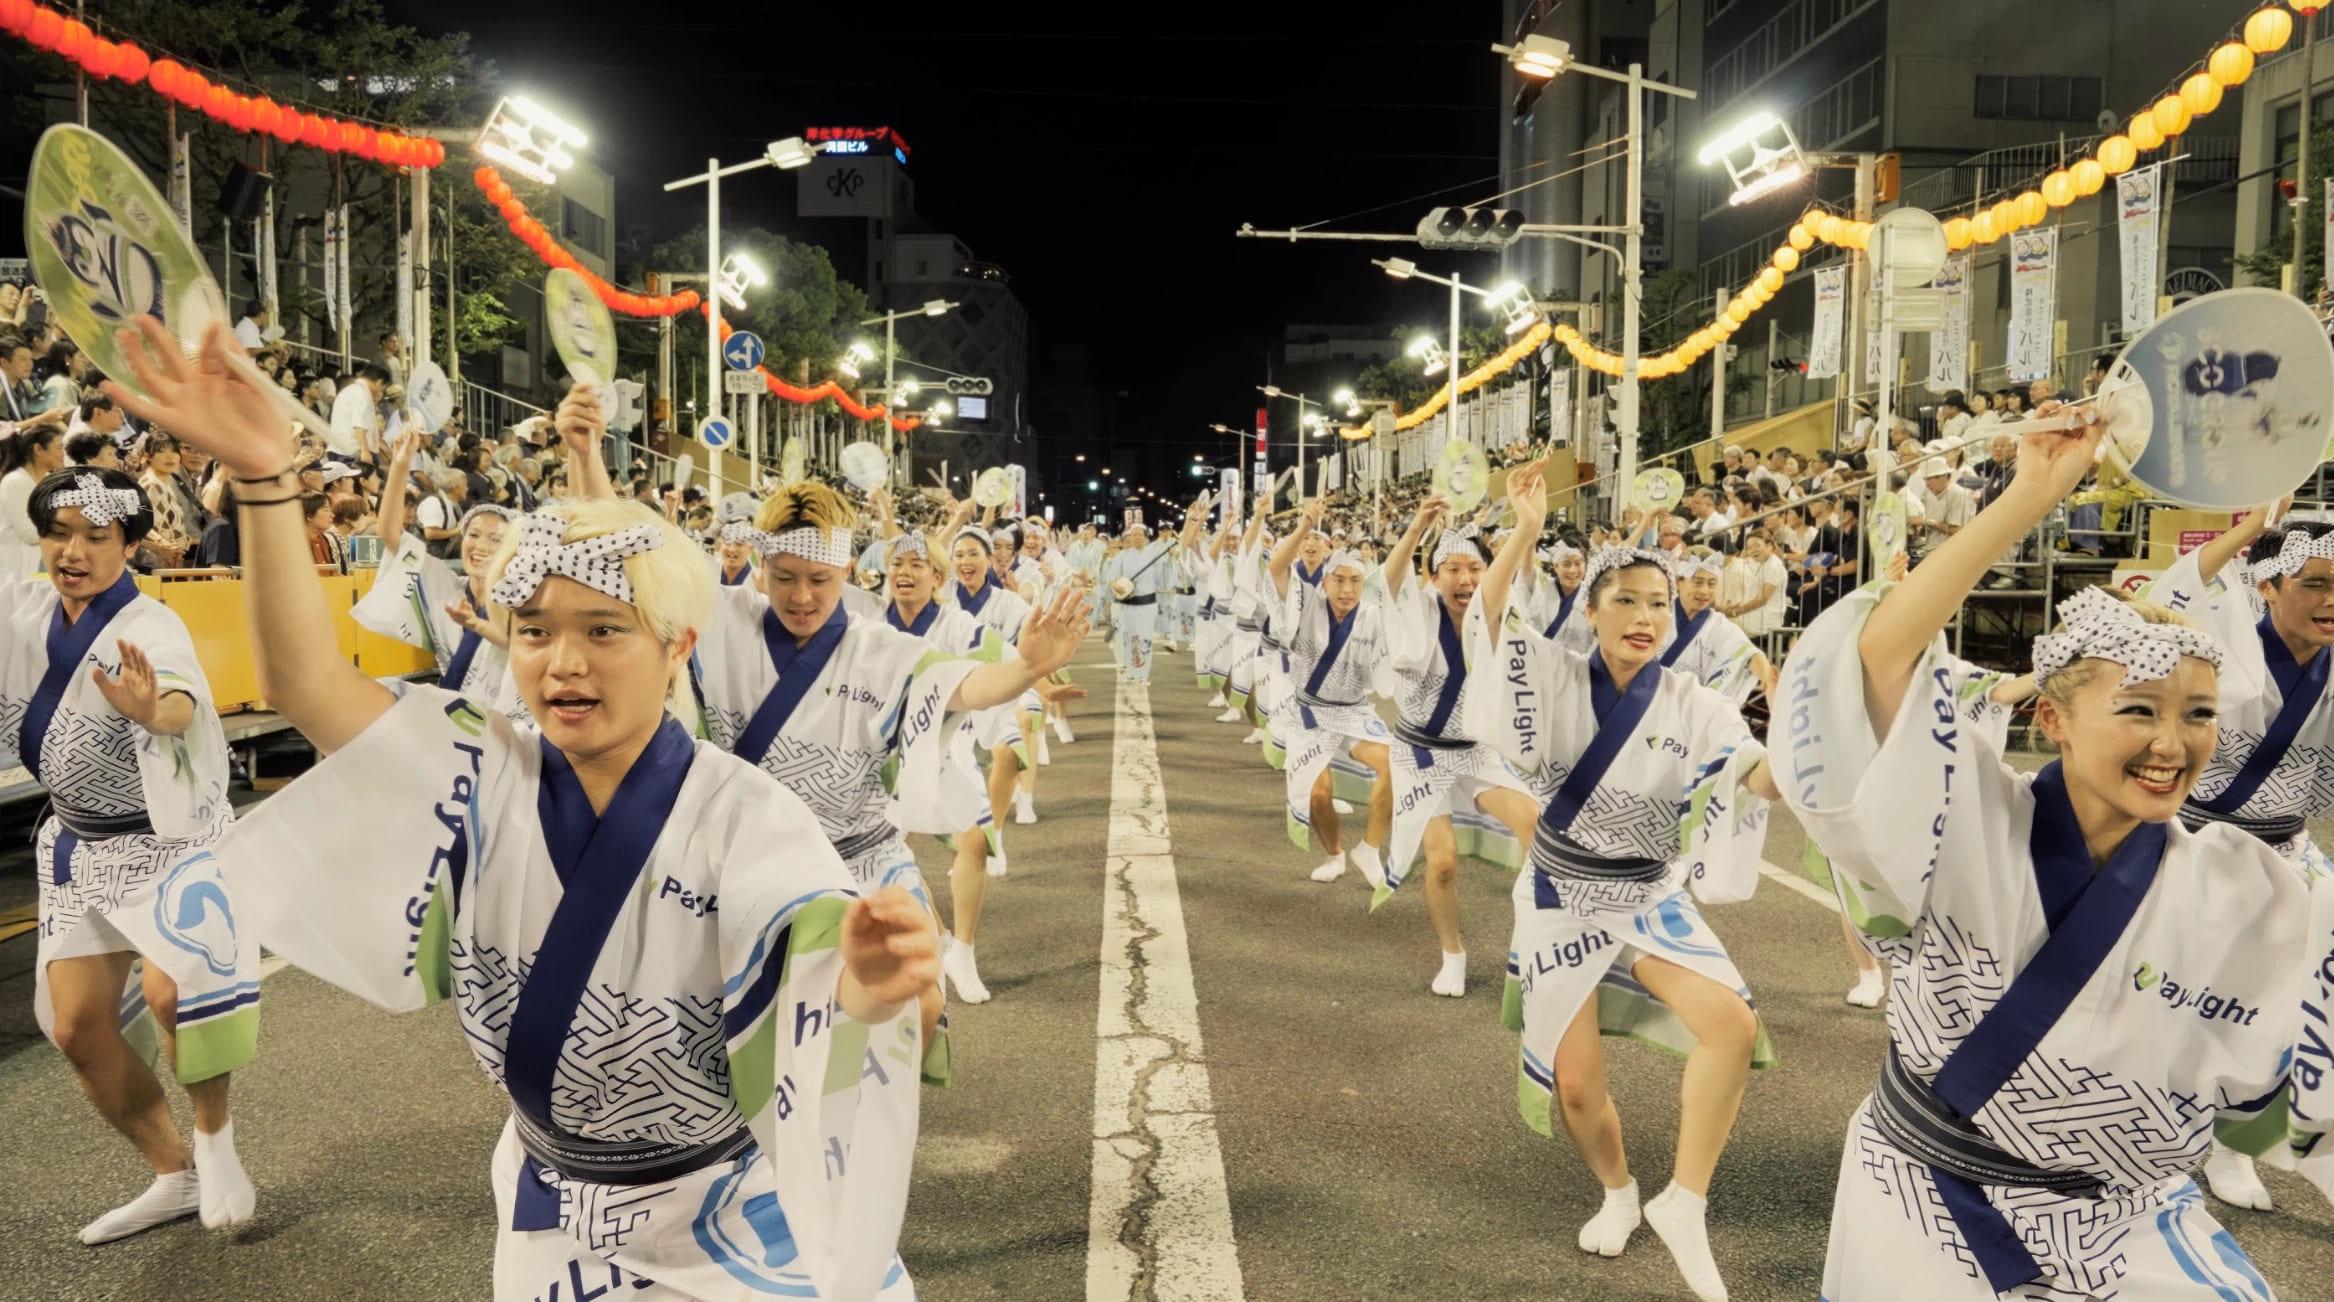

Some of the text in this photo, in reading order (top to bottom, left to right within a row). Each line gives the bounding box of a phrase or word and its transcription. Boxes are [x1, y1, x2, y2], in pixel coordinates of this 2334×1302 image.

[837, 684, 886, 711] PLight
[1507, 639, 1536, 755] PayLight
[1662, 737, 1690, 759] Pay
[2159, 970, 2260, 1026] ayight
